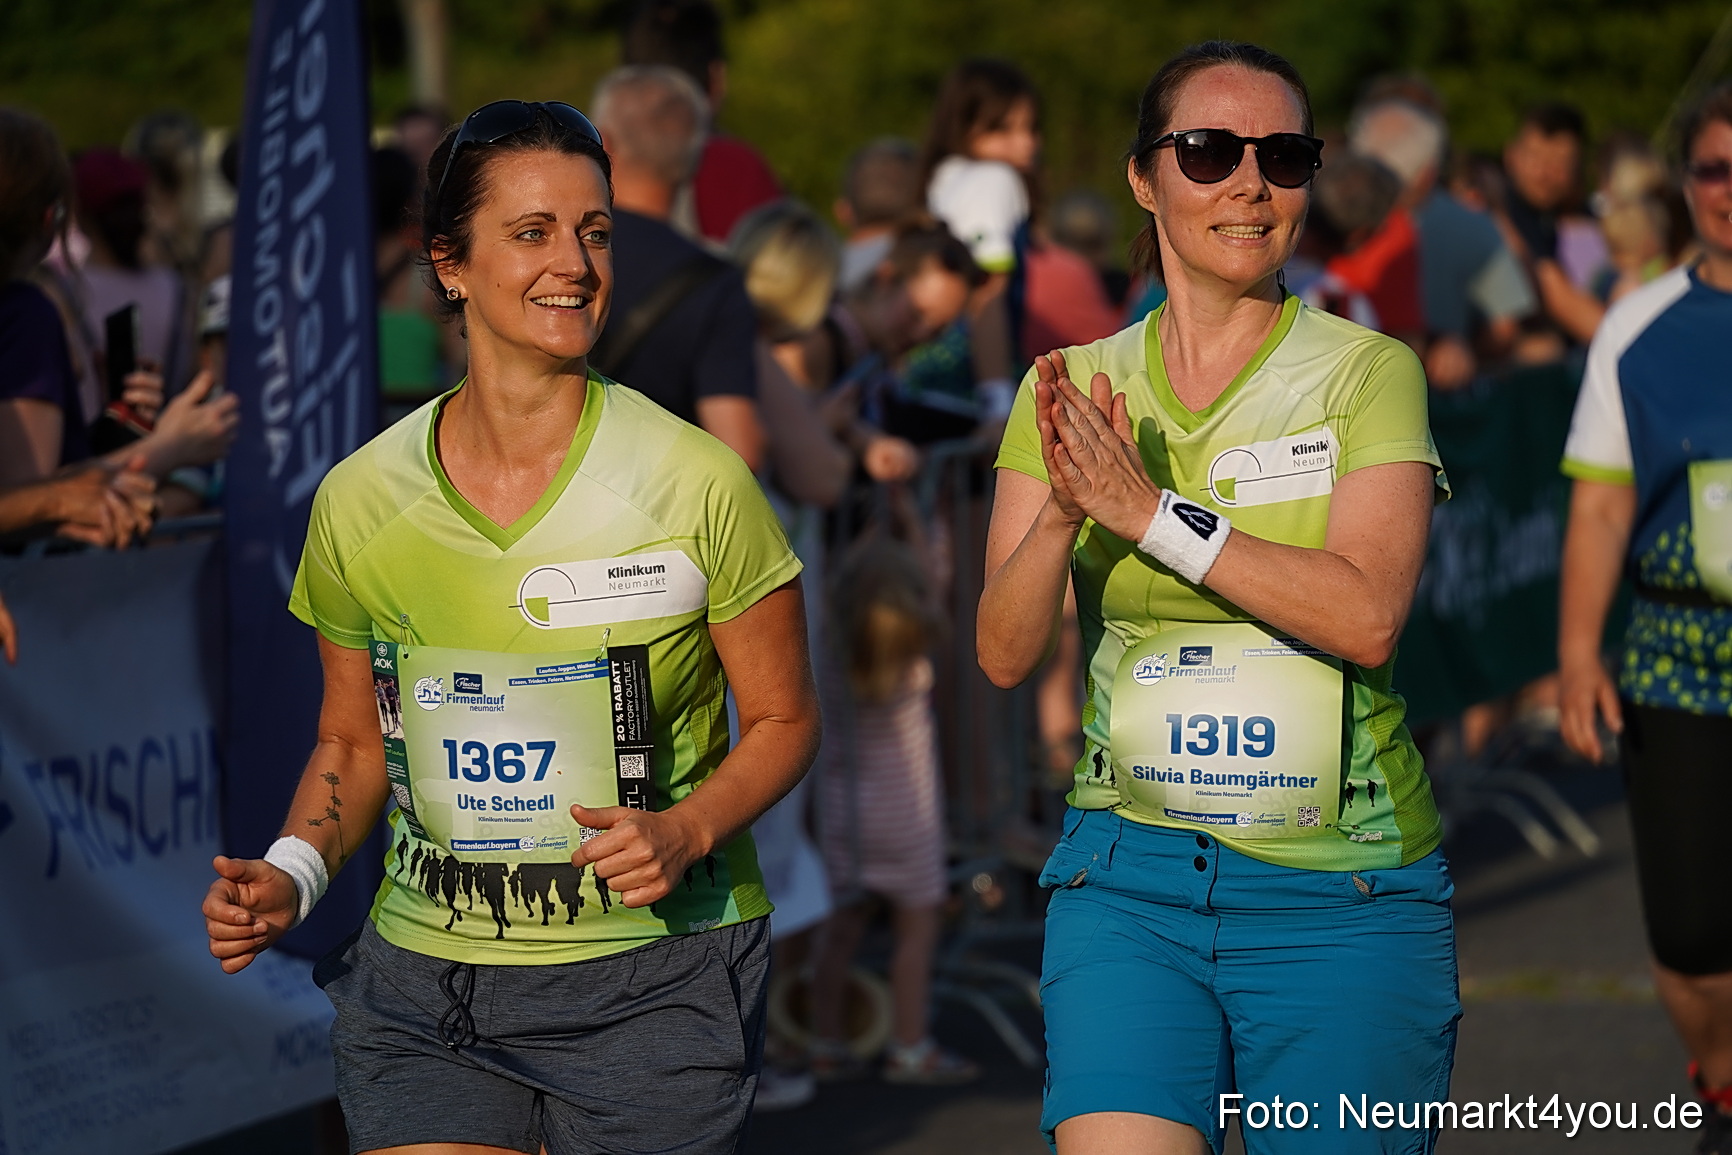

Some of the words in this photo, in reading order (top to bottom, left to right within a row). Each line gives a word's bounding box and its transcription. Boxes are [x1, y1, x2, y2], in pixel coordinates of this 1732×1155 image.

[1291, 440, 1329, 457] Klinik
[1292, 456, 1328, 468] Neum
[607, 563, 666, 580] Klinikum
[608, 577, 667, 591] Neumarkt
[373, 657, 394, 670] AOK
[1168, 664, 1237, 678] Firmenlauf
[611, 660, 624, 711] RABATT
[623, 660, 633, 698] OUTLET
[1194, 675, 1236, 684] neumarkt
[446, 692, 505, 705] Firmenlauf
[615, 713, 624, 723] %
[627, 700, 636, 741] FACTORY
[616, 725, 626, 741] 20
[1165, 713, 1276, 758] 1319
[442, 738, 557, 784] 1367
[1132, 765, 1185, 785] Silvia
[1190, 768, 1318, 791] Baumgärtner
[457, 793, 487, 811] Ute
[491, 793, 555, 812] Schedl
[1167, 810, 1234, 825] firmenlauf.bayern
[453, 841, 517, 851] firmenlauf.bayern
